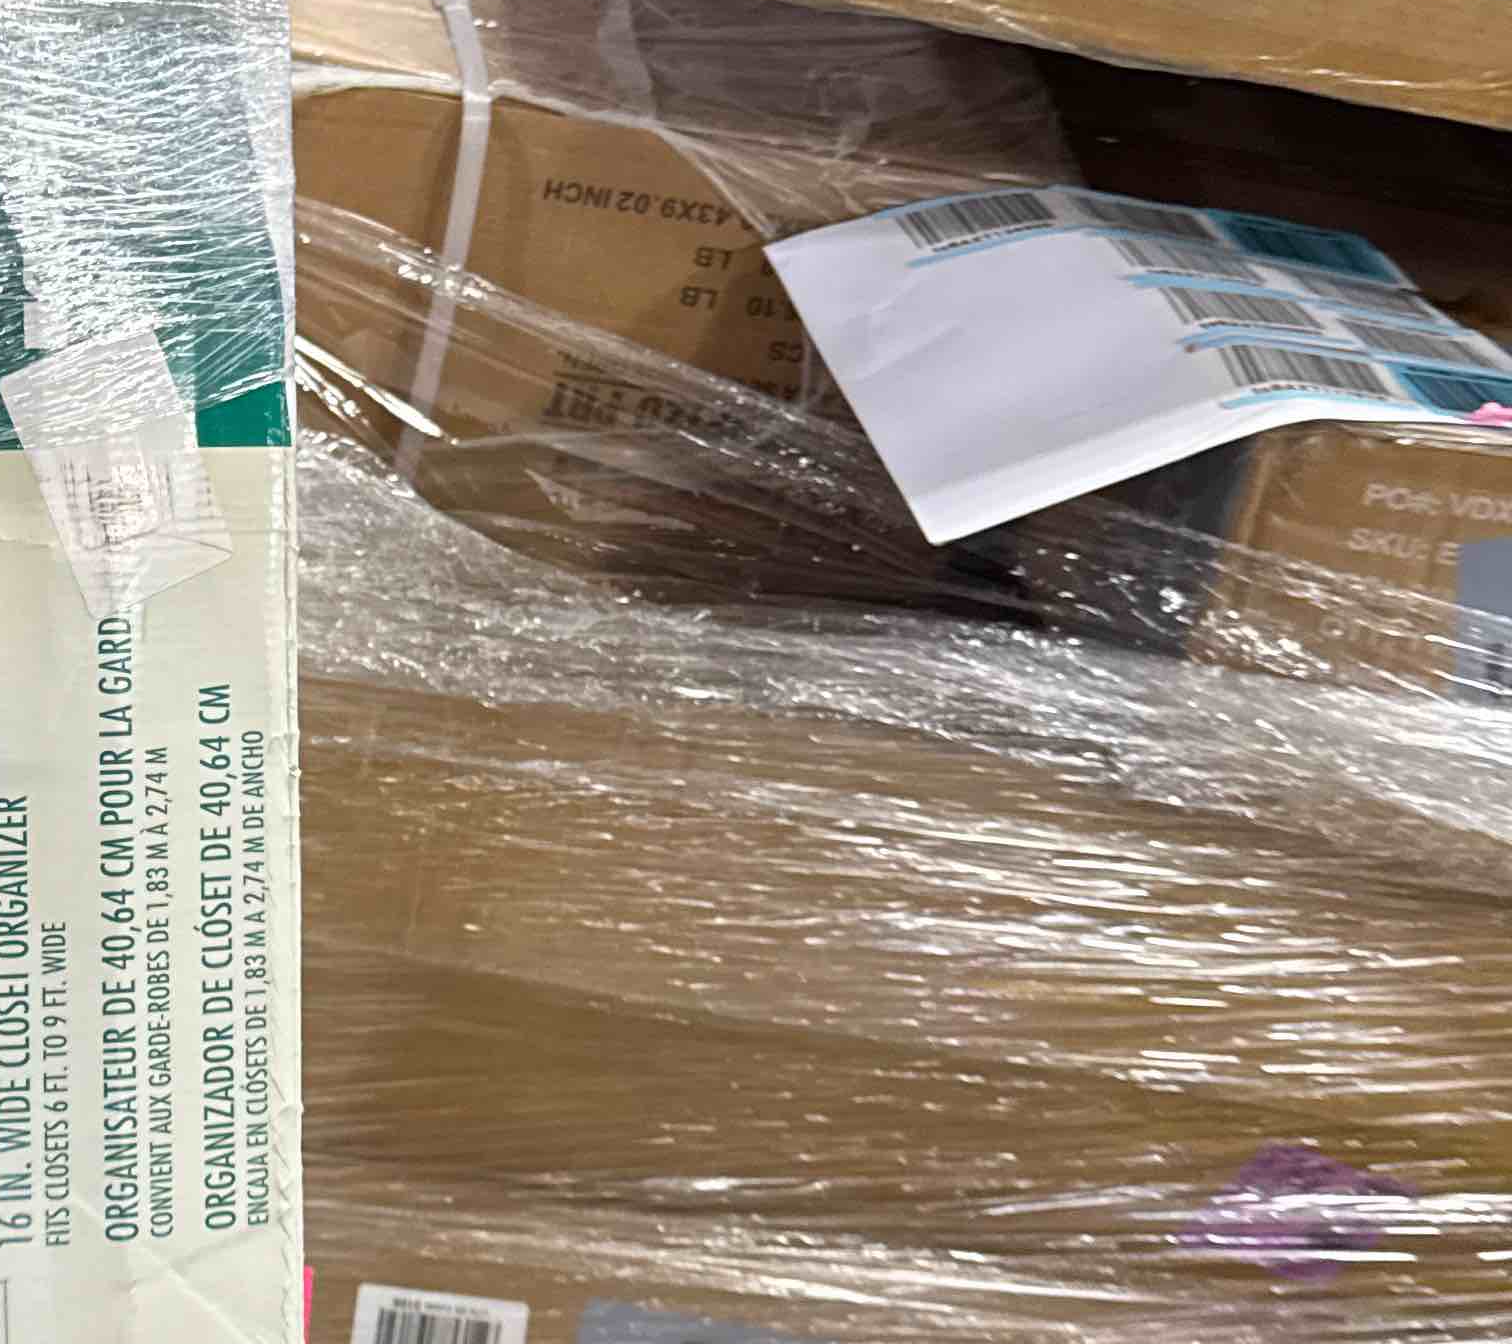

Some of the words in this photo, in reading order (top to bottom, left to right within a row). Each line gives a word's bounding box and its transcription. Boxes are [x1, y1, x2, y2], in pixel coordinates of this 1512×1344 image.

[543, 178, 612, 206] INCH
[694, 246, 733, 270] LB
[679, 285, 718, 310] LB
[97, 617, 132, 695] GARD
[98, 705, 133, 738] LA
[198, 684, 230, 725] CM
[144, 747, 168, 764] M
[241, 730, 265, 798] ANCHO
[99, 748, 134, 826] POUR
[144, 772, 172, 817] 2,74
[199, 735, 238, 817] 40,64
[139, 822, 169, 836] À
[242, 805, 265, 830] DE
[99, 836, 134, 878] CM
[145, 842, 169, 860] M
[199, 826, 232, 862] DE
[242, 836, 265, 853] M
[145, 867, 173, 910] 1,83
[242, 861, 269, 905] 2,74
[100, 888, 142, 970] 40,64
[146, 917, 169, 944] DE
[193, 872, 233, 969] CLÓSET
[243, 910, 265, 924] A
[40, 921, 67, 975] WIDE
[243, 930, 266, 947] M
[41, 981, 67, 1008] FT.
[244, 954, 270, 997] 1,83
[101, 979, 136, 1017] DE
[201, 978, 234, 1015] DE
[42, 1015, 67, 1028] 9
[146, 950, 172, 1087] GARDE-ROBES
[244, 1004, 267, 1030] DE
[42, 1034, 68, 1061] TO
[43, 1066, 68, 1093] FT.
[240, 1036, 269, 1115] CLÓSETS
[43, 1100, 69, 1113] 6
[149, 1094, 172, 1134] AUX
[102, 1026, 139, 1243] ORGANISATEUR
[202, 1023, 237, 1230] ORGANIZADOR
[246, 1122, 269, 1147] EN
[43, 1119, 70, 1201] CLOSETS
[149, 1142, 174, 1238] CONVIENT
[246, 1153, 269, 1226] ENCAJA
[45, 1207, 70, 1246] FITS
